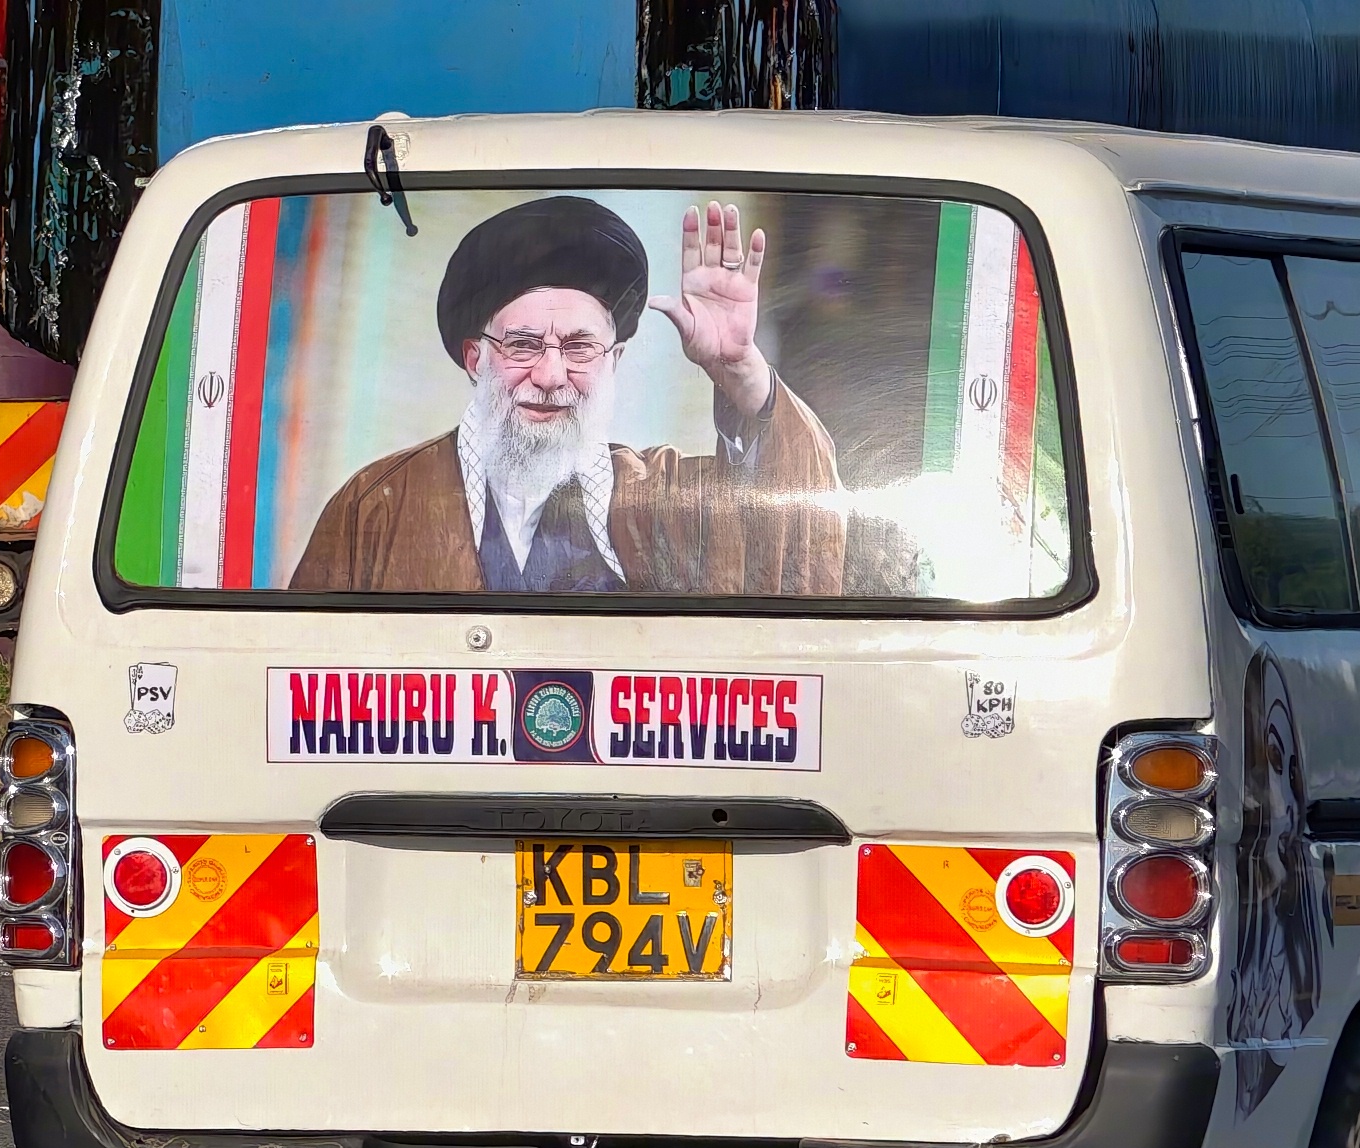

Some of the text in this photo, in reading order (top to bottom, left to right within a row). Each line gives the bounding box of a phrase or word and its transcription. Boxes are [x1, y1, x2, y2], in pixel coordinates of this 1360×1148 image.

[137, 686, 172, 702] PSV
[976, 697, 1013, 713] KPH
[983, 680, 1005, 696] 80
[290, 673, 798, 763] NAKURU K. SERVICES
[531, 843, 671, 906] KBL
[534, 911, 719, 974] 794V
